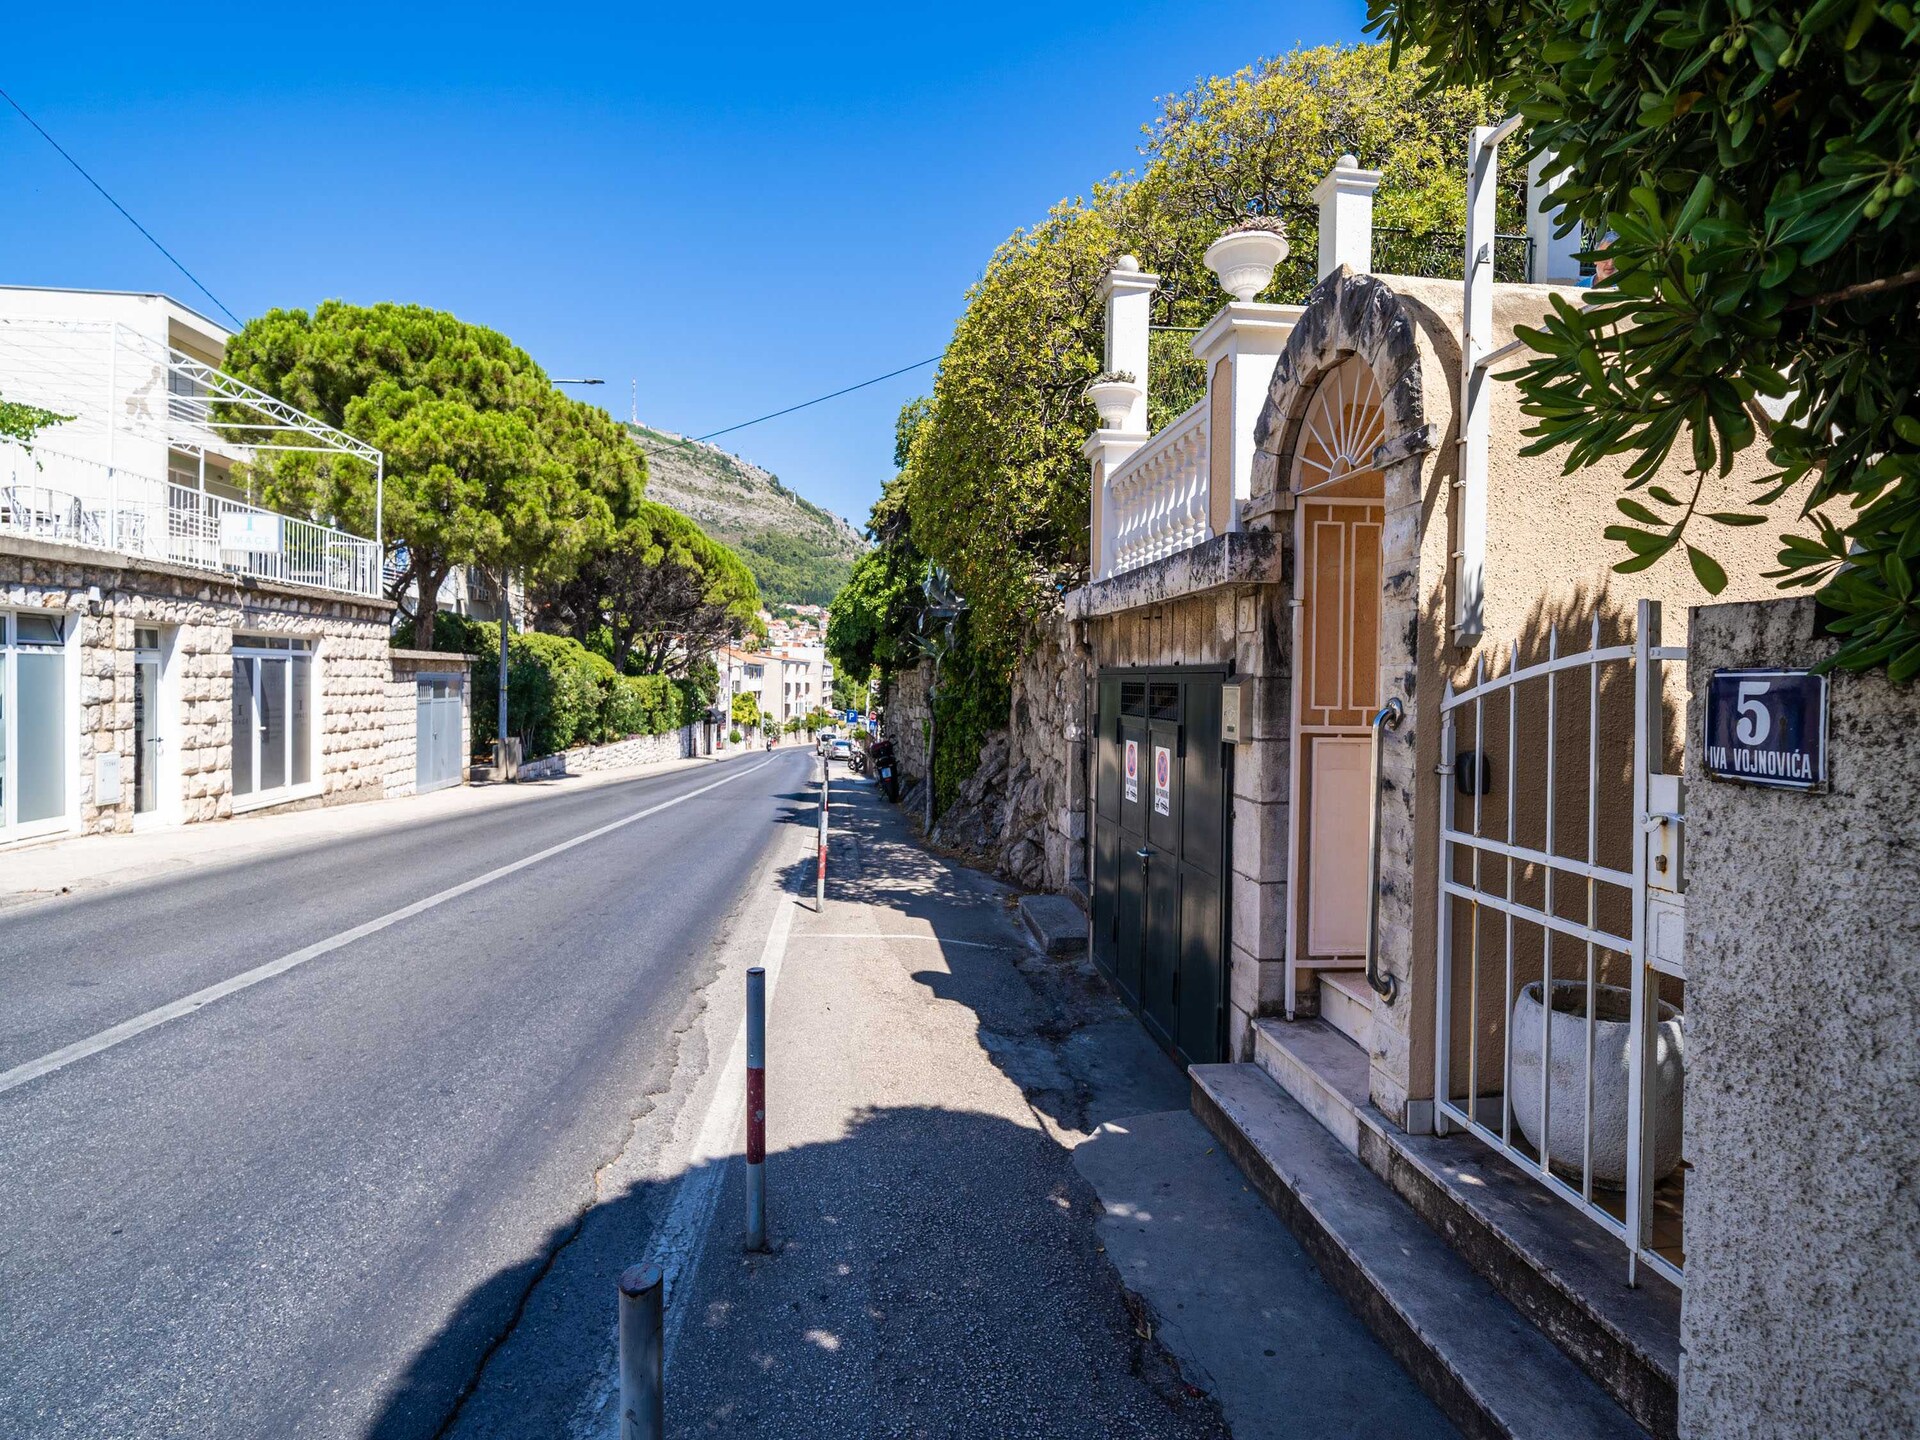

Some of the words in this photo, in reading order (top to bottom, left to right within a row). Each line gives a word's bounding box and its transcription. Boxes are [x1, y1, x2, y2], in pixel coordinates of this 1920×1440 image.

[229, 535, 272, 546] IMAGE
[849, 712, 855, 720] P
[1736, 681, 1771, 746] 5
[1710, 746, 1728, 770] IVA
[1733, 748, 1813, 779] VOJNOVIĆA
